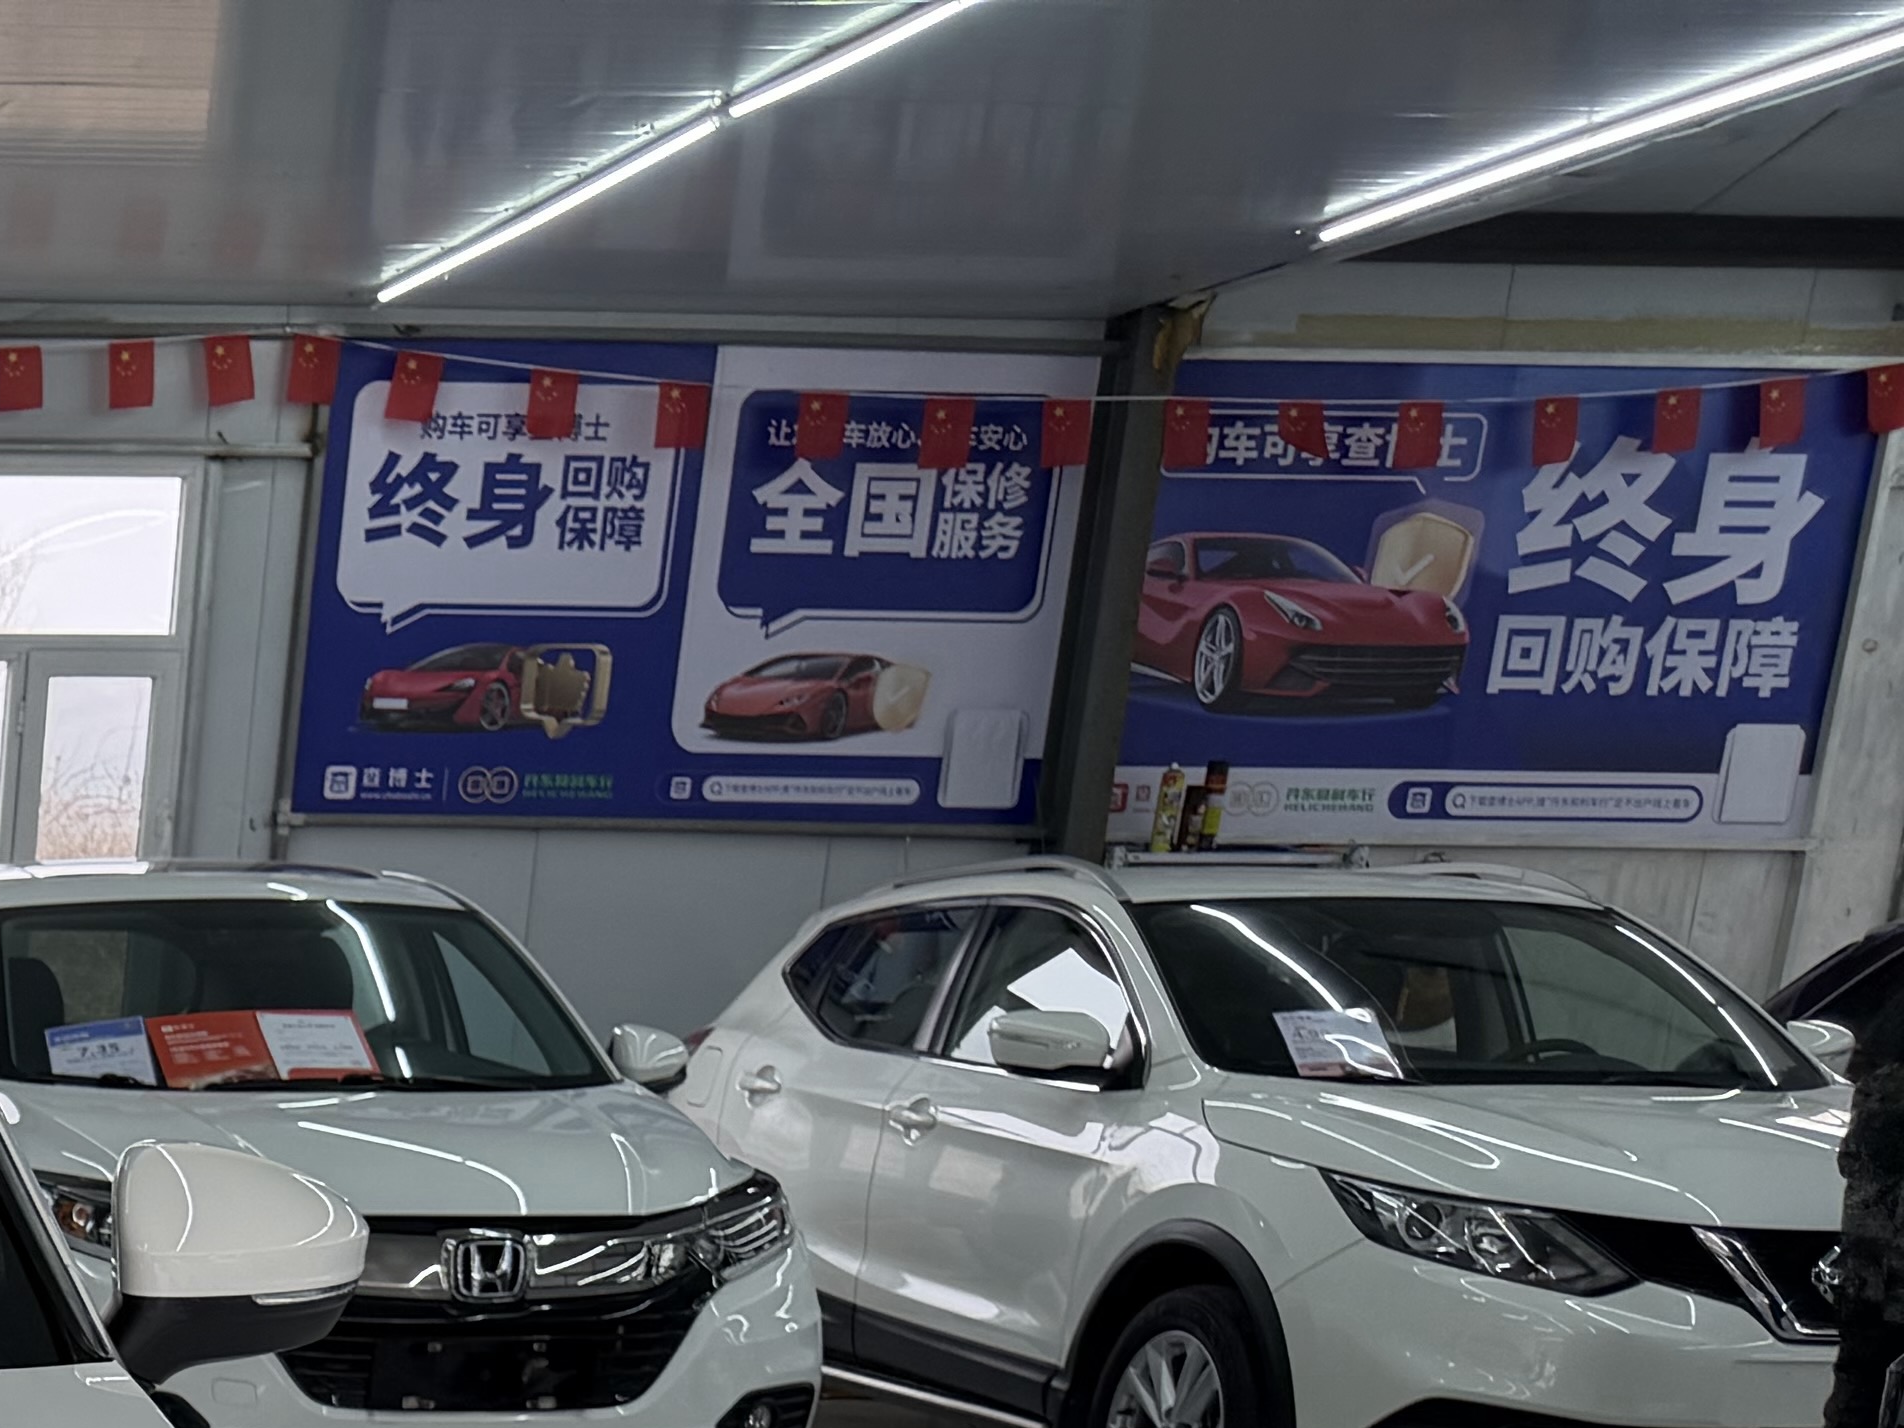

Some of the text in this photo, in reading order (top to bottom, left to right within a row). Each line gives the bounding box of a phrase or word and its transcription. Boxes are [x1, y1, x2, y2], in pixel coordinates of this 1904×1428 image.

[419, 411, 611, 442] 购车可享士
[767, 419, 1028, 451] 让车放心、安心
[1206, 420, 1469, 468] 车可享查士
[364, 449, 556, 550] 终身
[559, 453, 652, 502] 回购
[940, 461, 1033, 511] 保修
[554, 504, 646, 553] 保障
[749, 456, 938, 560] 全国
[1507, 434, 1827, 606] 终身
[931, 511, 1025, 561] 服务
[1485, 613, 1801, 698] 回购保障
